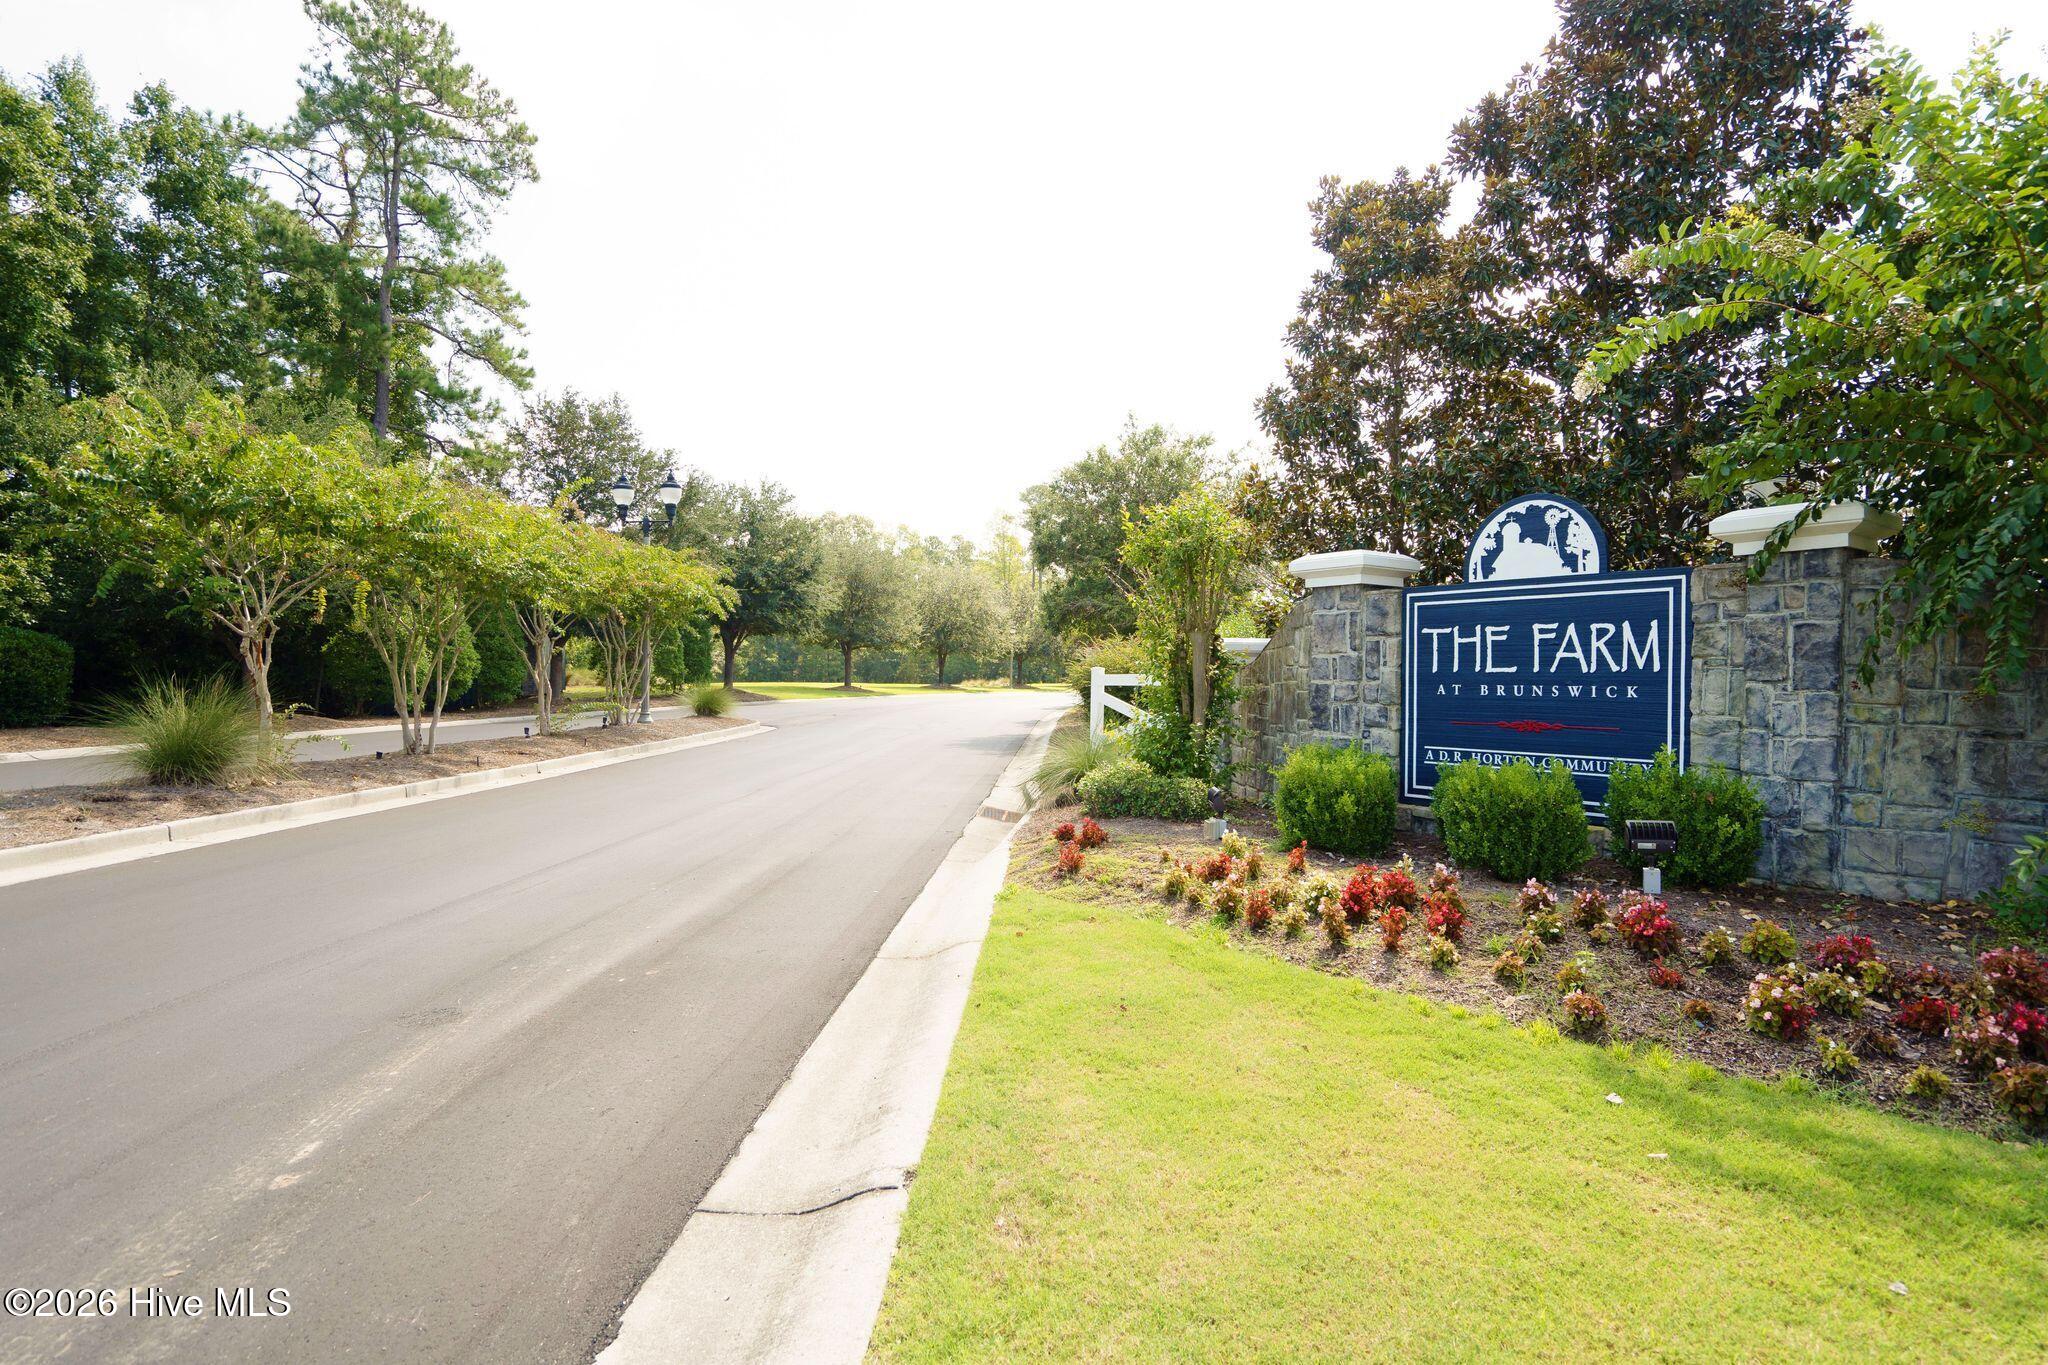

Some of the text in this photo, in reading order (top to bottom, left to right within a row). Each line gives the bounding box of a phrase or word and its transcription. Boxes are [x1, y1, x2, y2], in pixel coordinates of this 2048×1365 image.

[1421, 619, 1661, 674] THE FARM
[1437, 684, 1639, 699] AT BRUNSWICK
[1425, 750, 1434, 760] A
